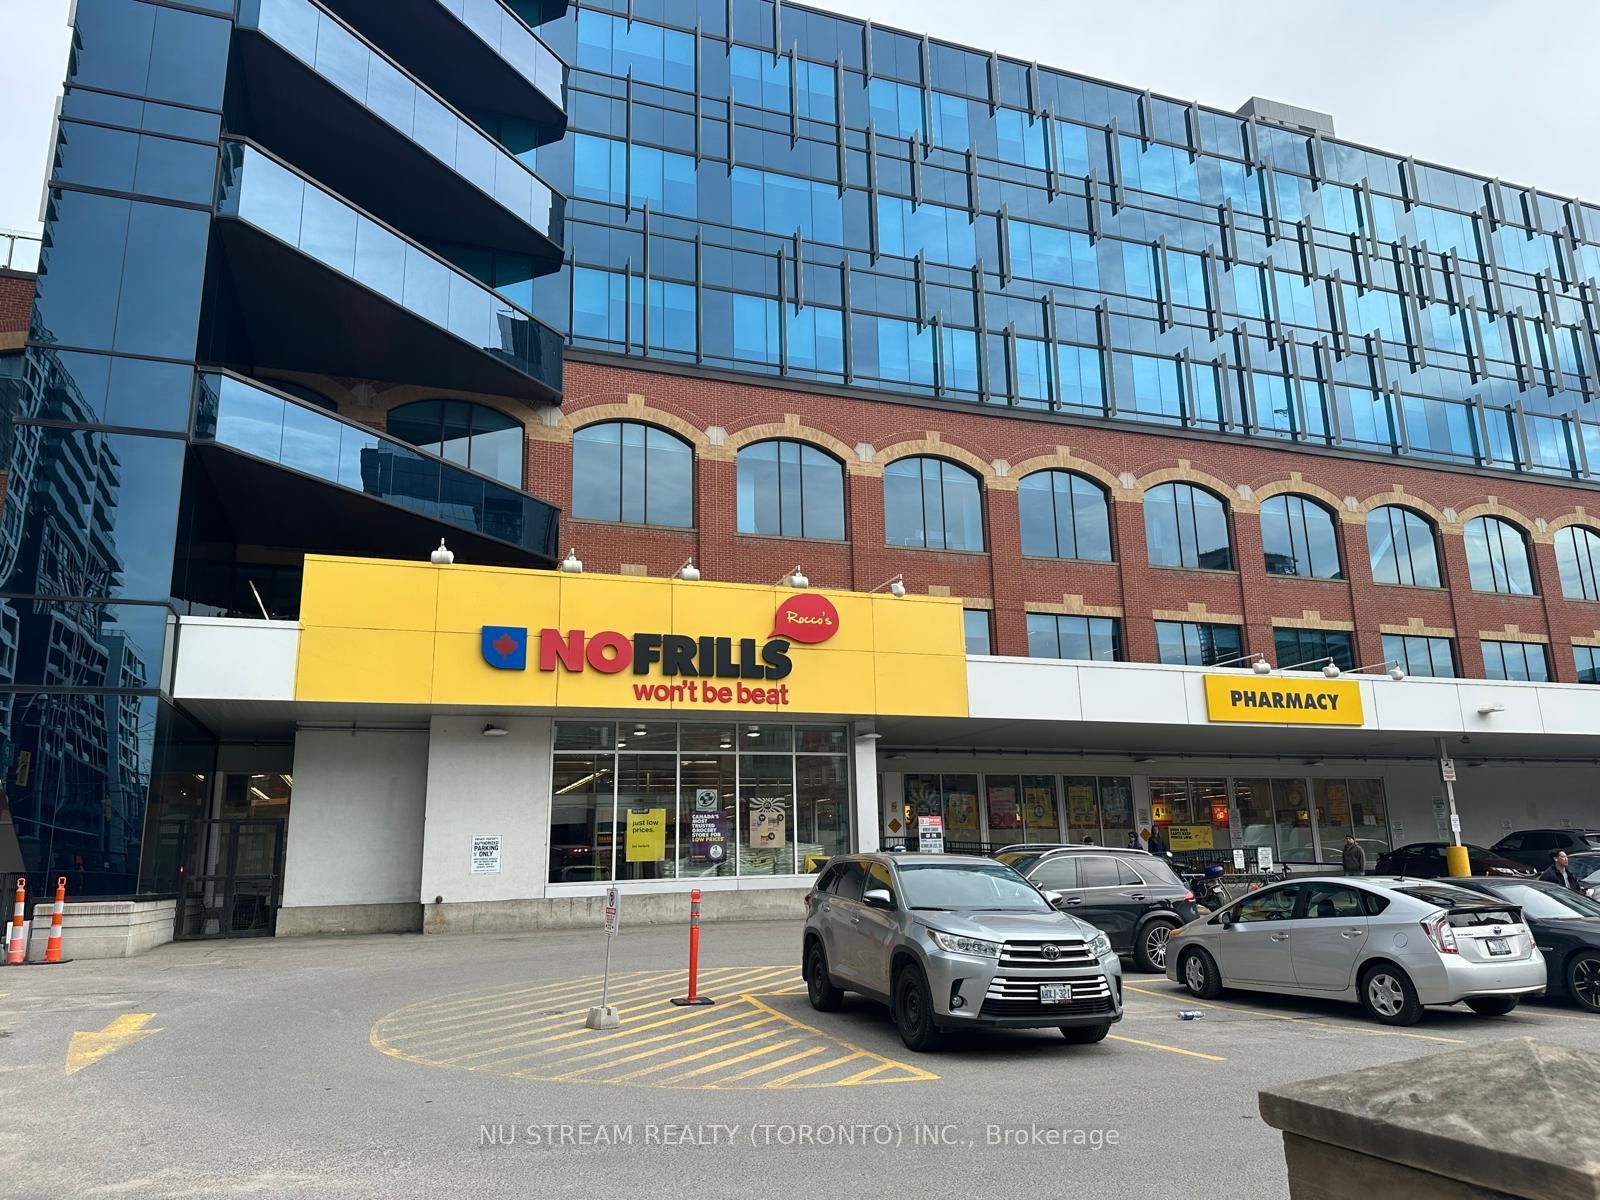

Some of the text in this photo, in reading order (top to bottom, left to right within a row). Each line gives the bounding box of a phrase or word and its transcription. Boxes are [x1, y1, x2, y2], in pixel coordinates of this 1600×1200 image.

[786, 610, 832, 625] Rocco's
[633, 680, 789, 705] won't be beat
[1230, 690, 1339, 710] PHARMACY
